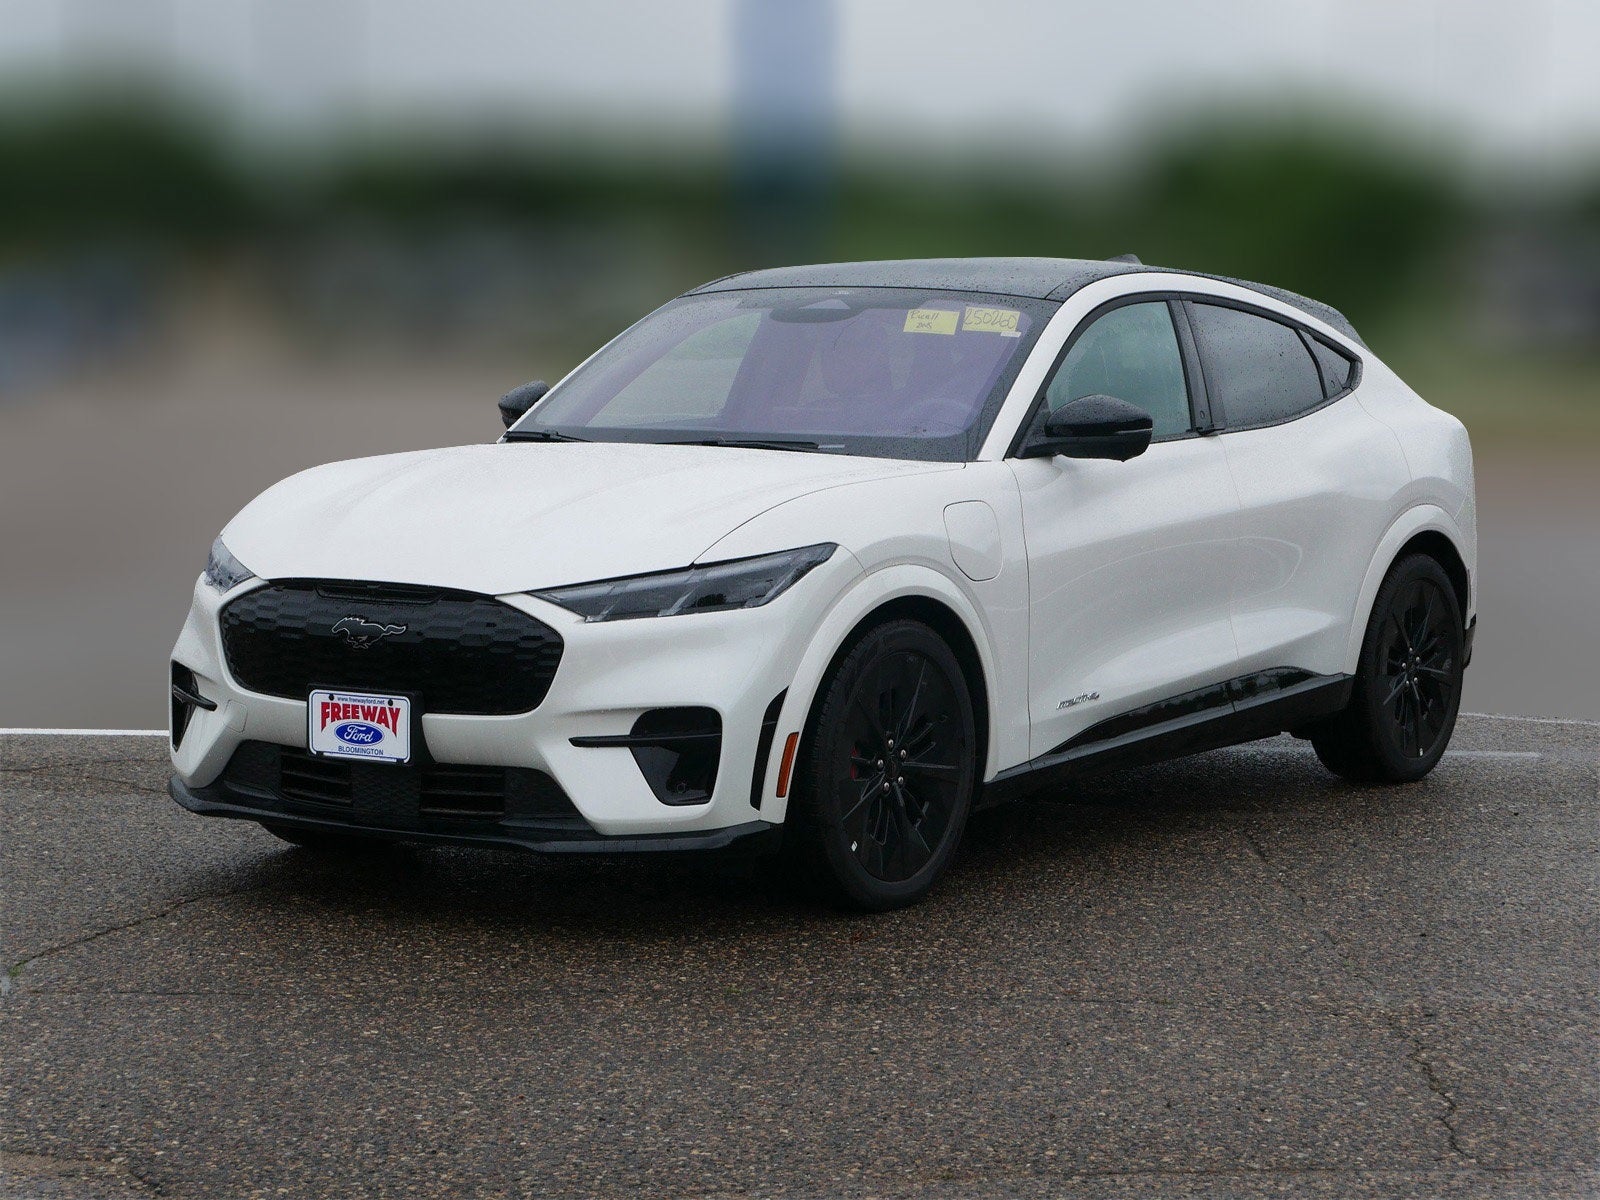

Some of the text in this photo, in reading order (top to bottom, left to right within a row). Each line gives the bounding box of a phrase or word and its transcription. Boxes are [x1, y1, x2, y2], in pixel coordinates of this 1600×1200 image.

[321, 702, 401, 738] FREEWAY
[343, 724, 374, 742] Ford
[338, 745, 384, 756] BLOOMINGTON
